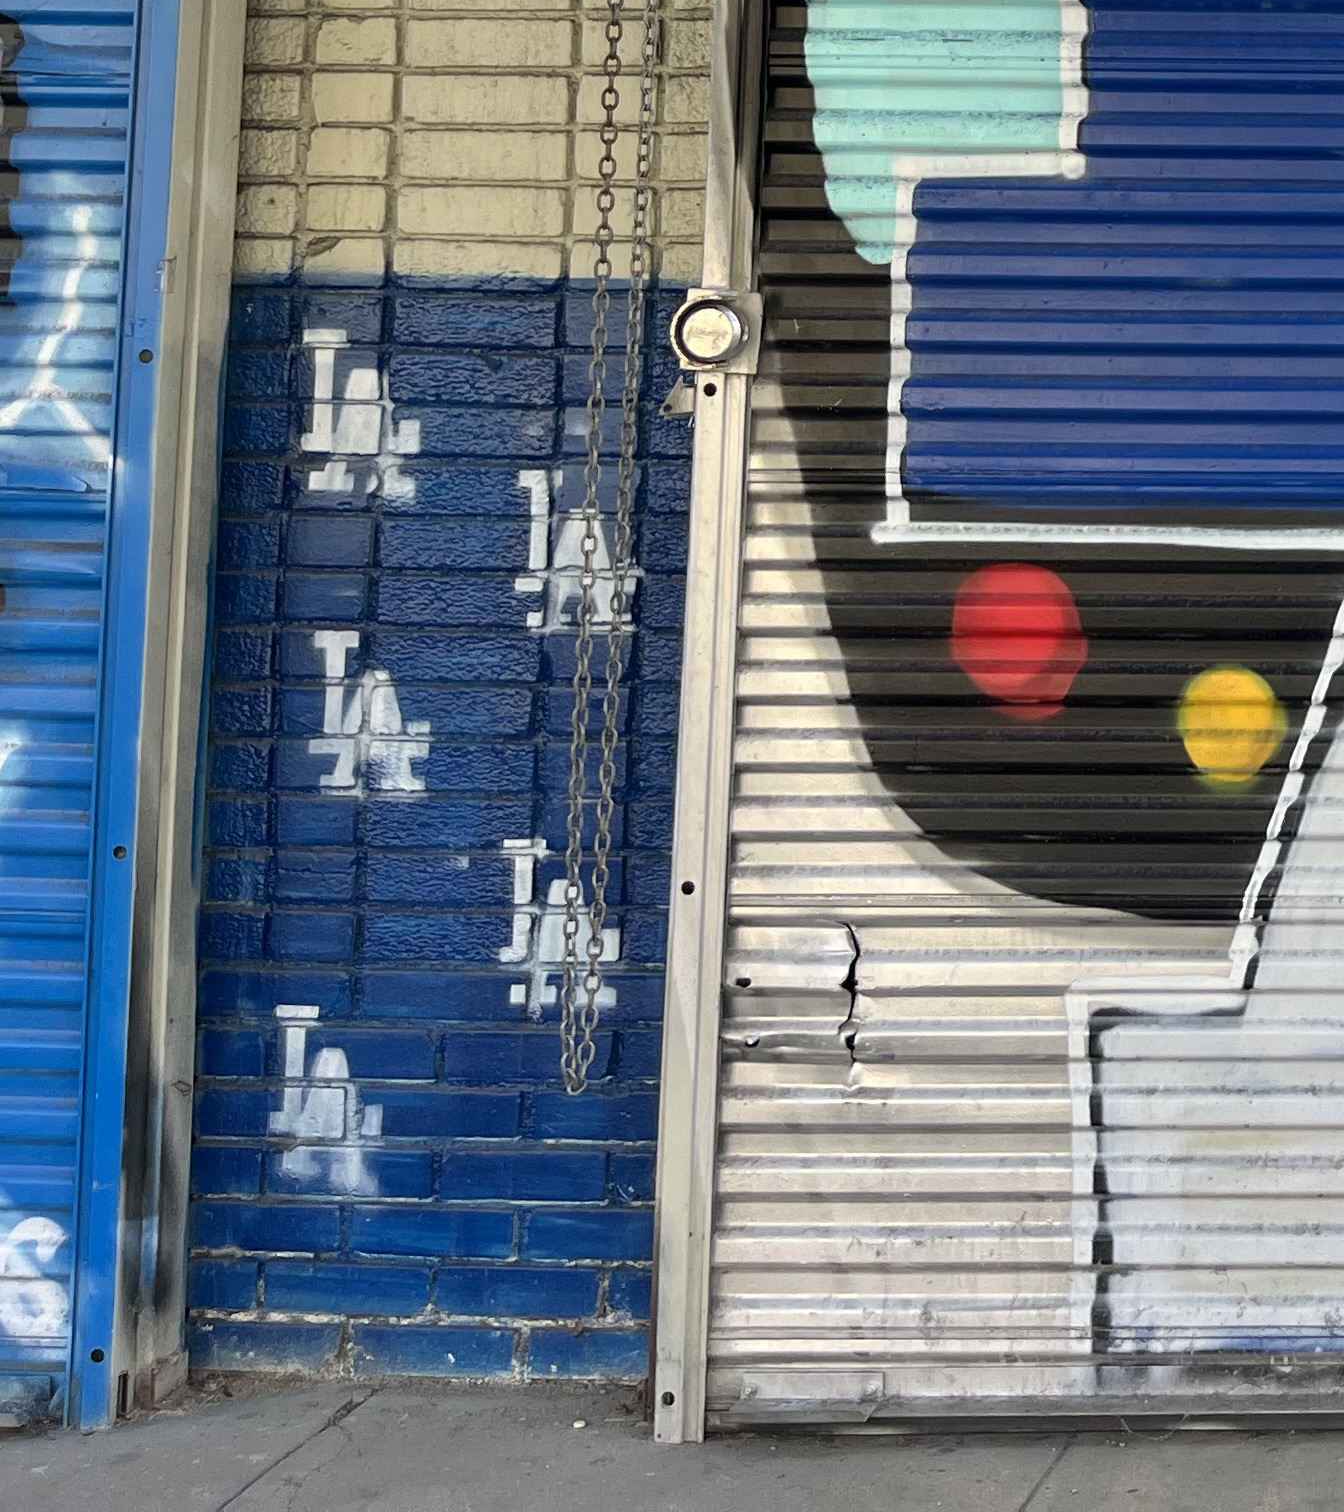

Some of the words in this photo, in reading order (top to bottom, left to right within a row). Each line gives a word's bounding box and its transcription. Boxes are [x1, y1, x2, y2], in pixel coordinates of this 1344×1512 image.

[301, 329, 422, 502] LA
[514, 470, 645, 632] LA
[308, 630, 430, 797] LA
[498, 839, 621, 1022] LA
[268, 1004, 384, 1194] LA
